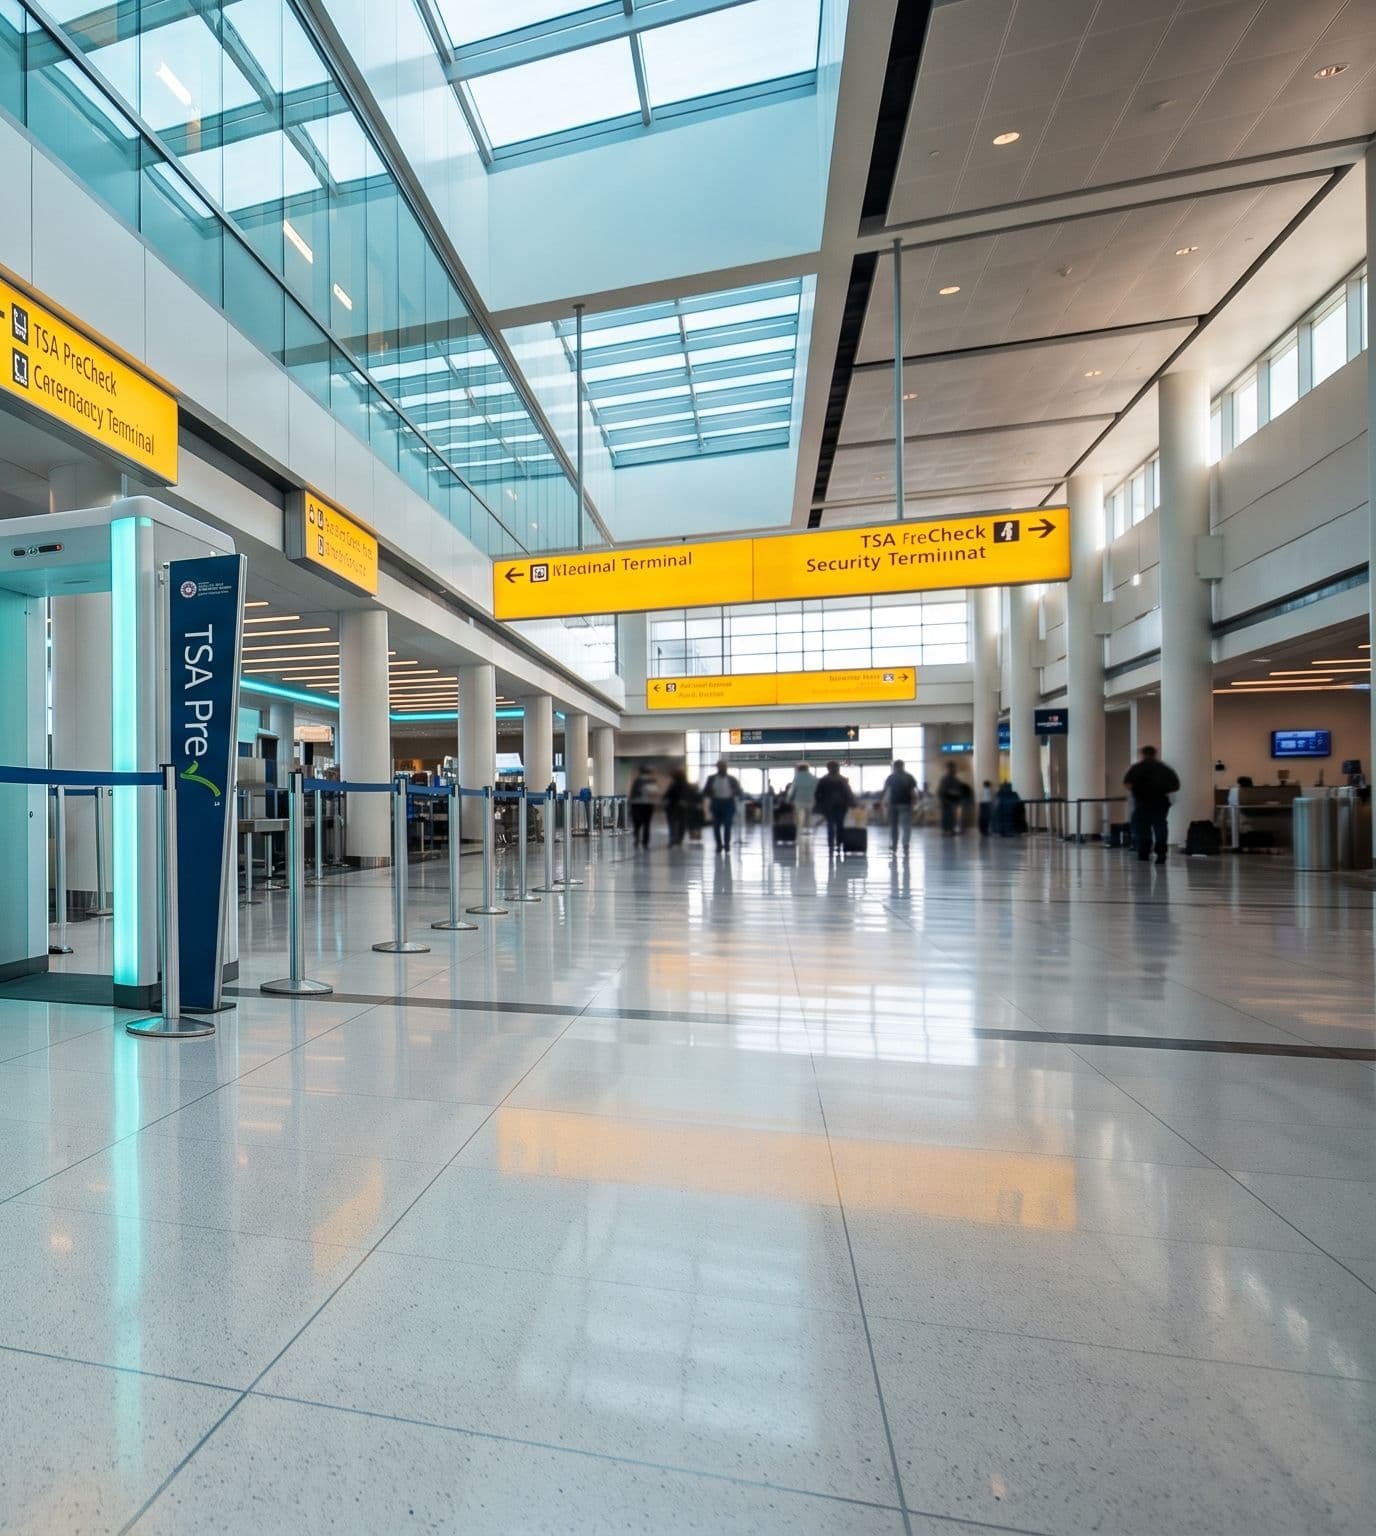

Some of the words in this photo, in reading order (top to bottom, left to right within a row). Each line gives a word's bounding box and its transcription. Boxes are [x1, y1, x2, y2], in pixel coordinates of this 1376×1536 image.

[33, 323, 60, 361] TSA
[63, 342, 118, 397] PreCheck
[860, 533, 897, 548] TSA
[622, 551, 693, 571] Terminal
[806, 555, 882, 572] Security
[184, 623, 214, 690] TSA
[184, 699, 214, 757] Pre
